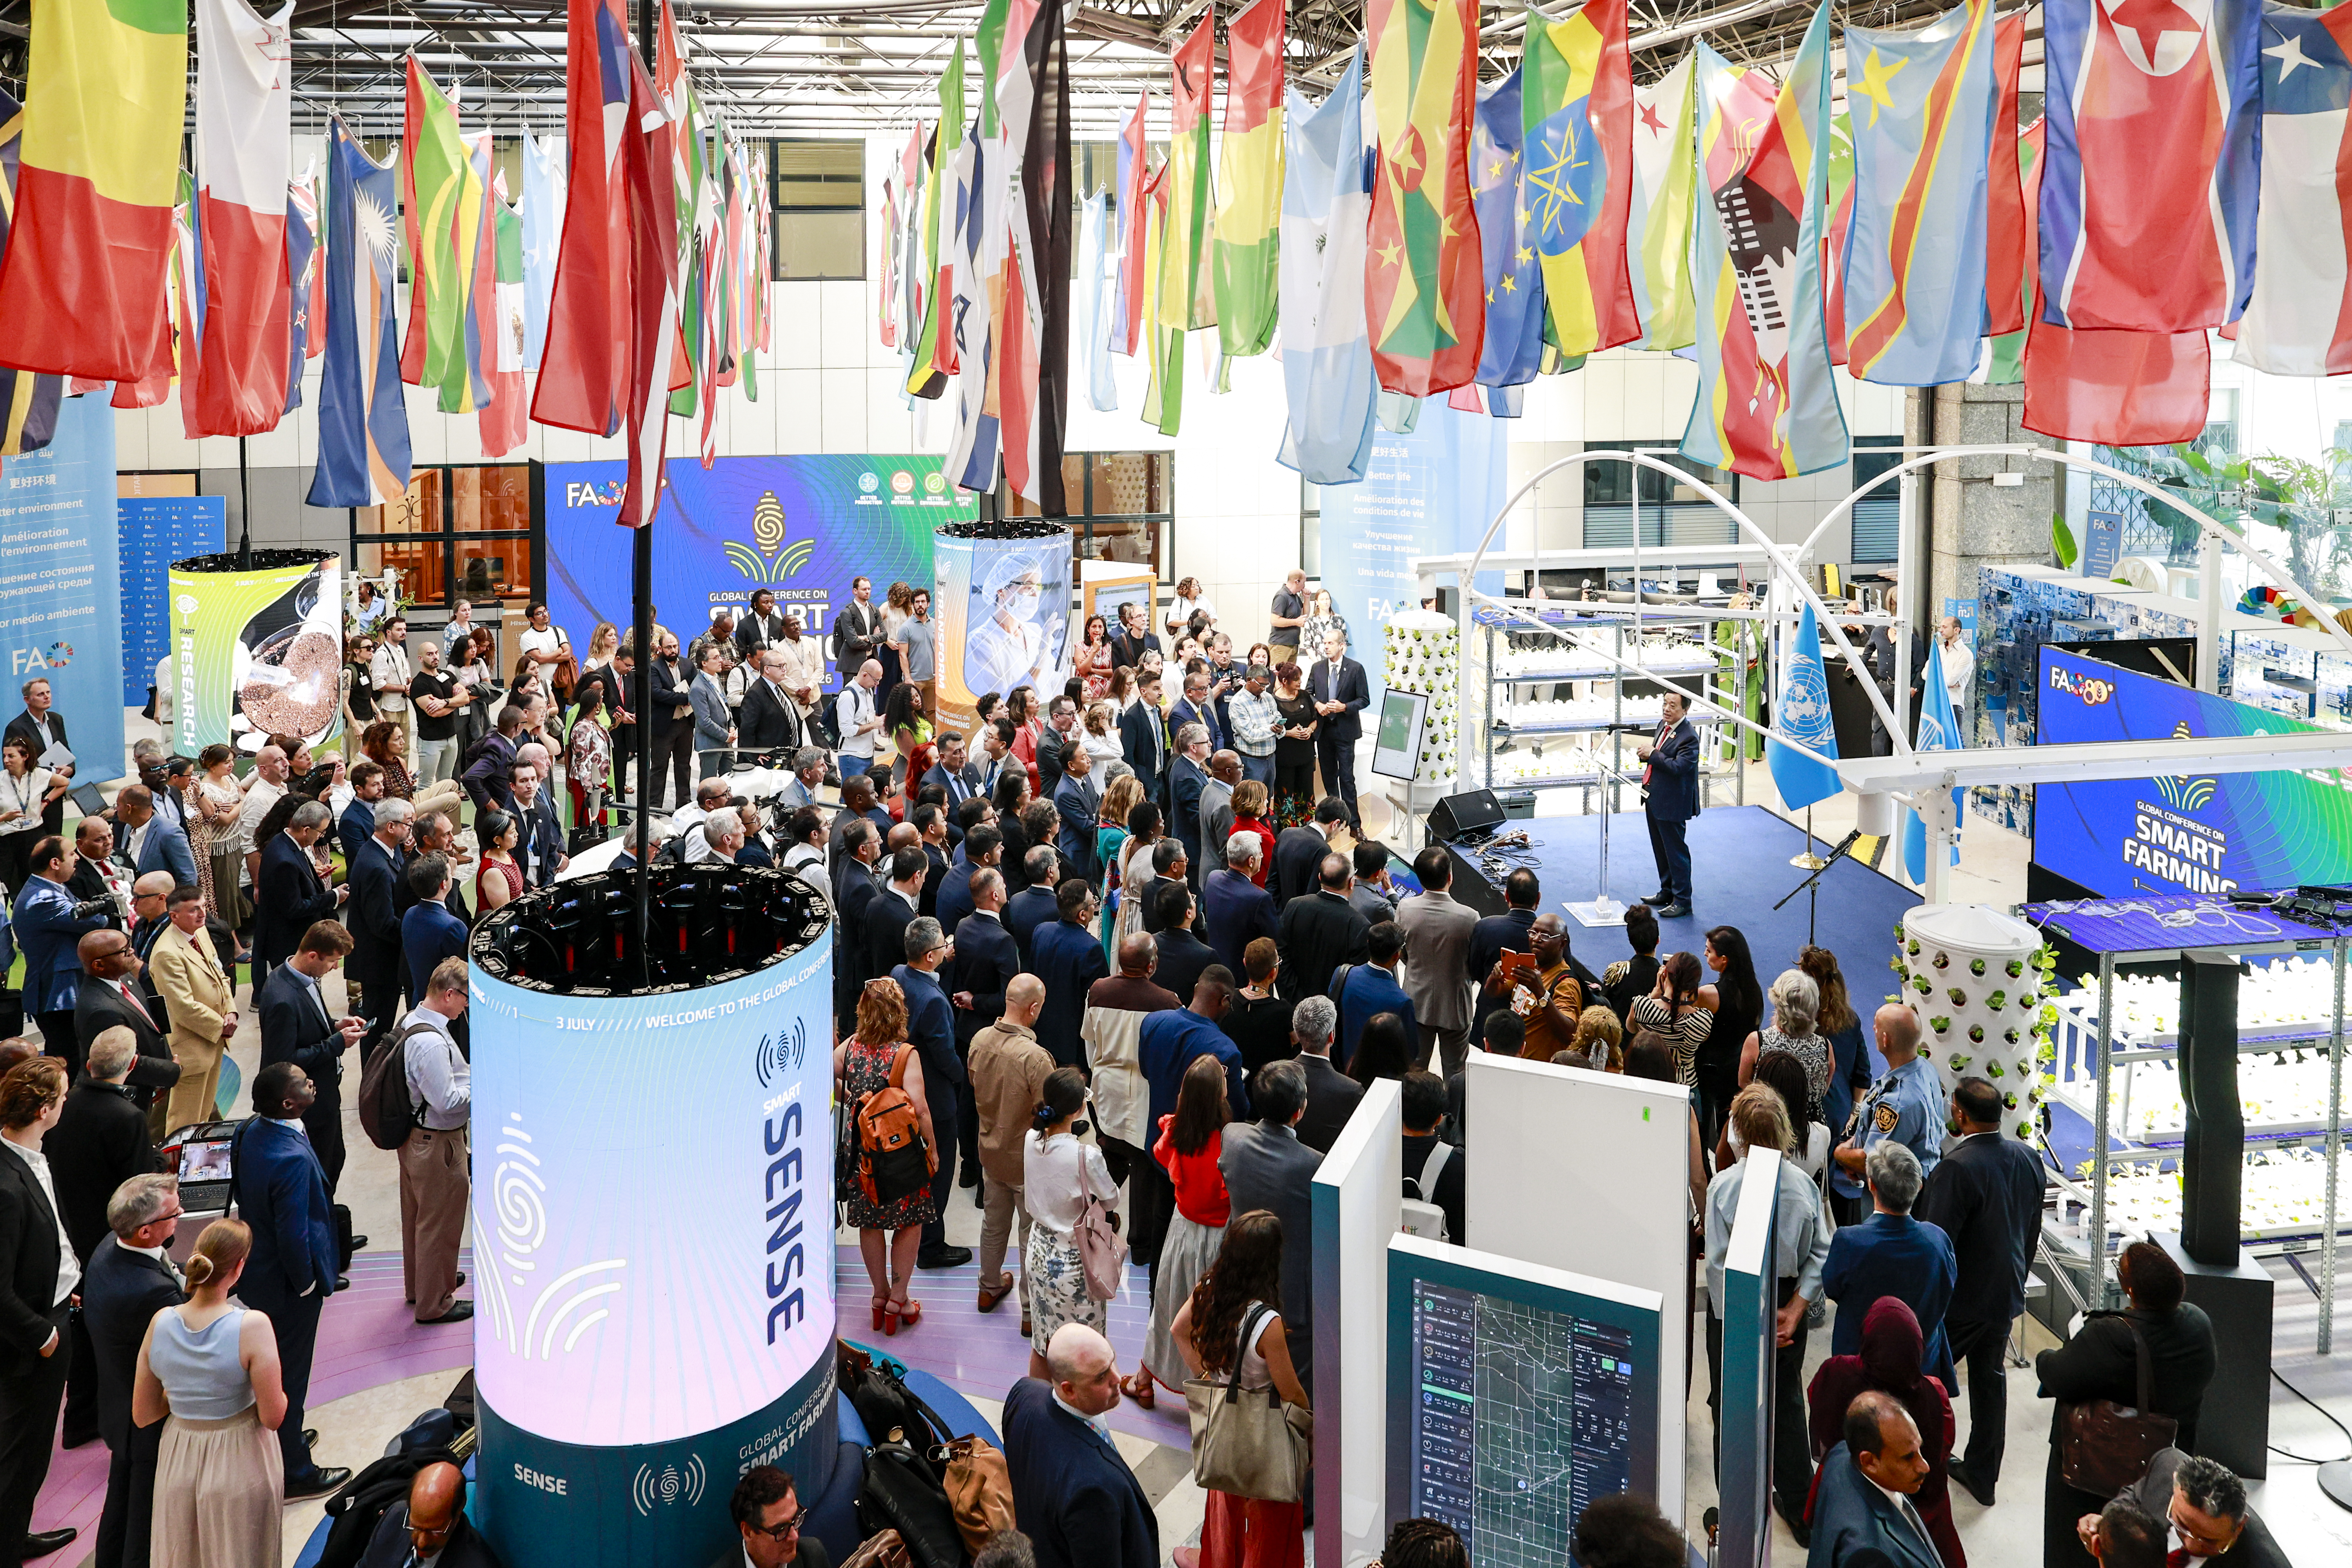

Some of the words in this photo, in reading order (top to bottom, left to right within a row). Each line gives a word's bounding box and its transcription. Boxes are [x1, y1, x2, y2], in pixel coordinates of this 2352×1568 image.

[1371, 447, 1408, 458] 更好生活
[9, 474, 57, 489] 更好环境
[1368, 471, 1395, 480] Better
[1397, 472, 1411, 481] life
[0, 505, 16, 517] tter
[18, 499, 83, 514] environment
[1354, 494, 1408, 505] Amélioration
[1410, 497, 1425, 506] des
[1354, 506, 1399, 516] conditions
[1400, 508, 1411, 517] de
[1412, 509, 1425, 518] vie
[2093, 519, 2116, 532] FAO
[1, 527, 69, 543] Amélioration
[1365, 530, 1414, 541] Улучшение
[1, 538, 87, 557] l'environnement
[1353, 542, 1392, 551] качества
[1394, 545, 1421, 554] жизни
[0, 572, 37, 584] шение
[40, 564, 95, 578] состояния
[275, 575, 304, 583] WELCOME
[1358, 568, 1374, 576] Una
[1376, 568, 1394, 578] vida
[0, 580, 55, 599] ружающей
[58, 578, 92, 590] среды
[709, 591, 747, 602] GLOBAL
[748, 590, 811, 601] CFERENCE
[813, 590, 828, 599] ON
[13, 612, 45, 626] medio
[47, 606, 95, 620] ambiente
[936, 590, 946, 689] TRANSFORM
[12, 641, 74, 675] FAO
[2249, 650, 2263, 660] FAO
[818, 674, 832, 684] 26
[180, 636, 196, 747] RESEARCH
[941, 708, 962, 719] CONFERENCE
[944, 718, 970, 729] FARMING
[2137, 801, 2164, 818] GLOBAL
[2165, 811, 2212, 837] CONFERENCE
[2212, 830, 2225, 842] ON
[2136, 814, 2226, 870] SMART
[2124, 838, 2237, 893] FARMING
[2134, 878, 2138, 887] 1
[513, 1007, 518, 1018] 1
[556, 1017, 564, 1029] 3
[566, 1017, 596, 1031] JULY
[645, 1006, 717, 1029] WELCOME
[718, 1000, 737, 1015] TO
[739, 992, 761, 1011] THE
[762, 974, 799, 1002] GLOBAL
[763, 1081, 802, 1116] SMART
[764, 1101, 804, 1347] SENSE
[739, 1424, 785, 1460] GLOBAL
[786, 1366, 831, 1430] CONFERENCE
[739, 1429, 797, 1481] SMART
[799, 1371, 836, 1439] FARMING
[514, 1463, 567, 1495] SENSE
